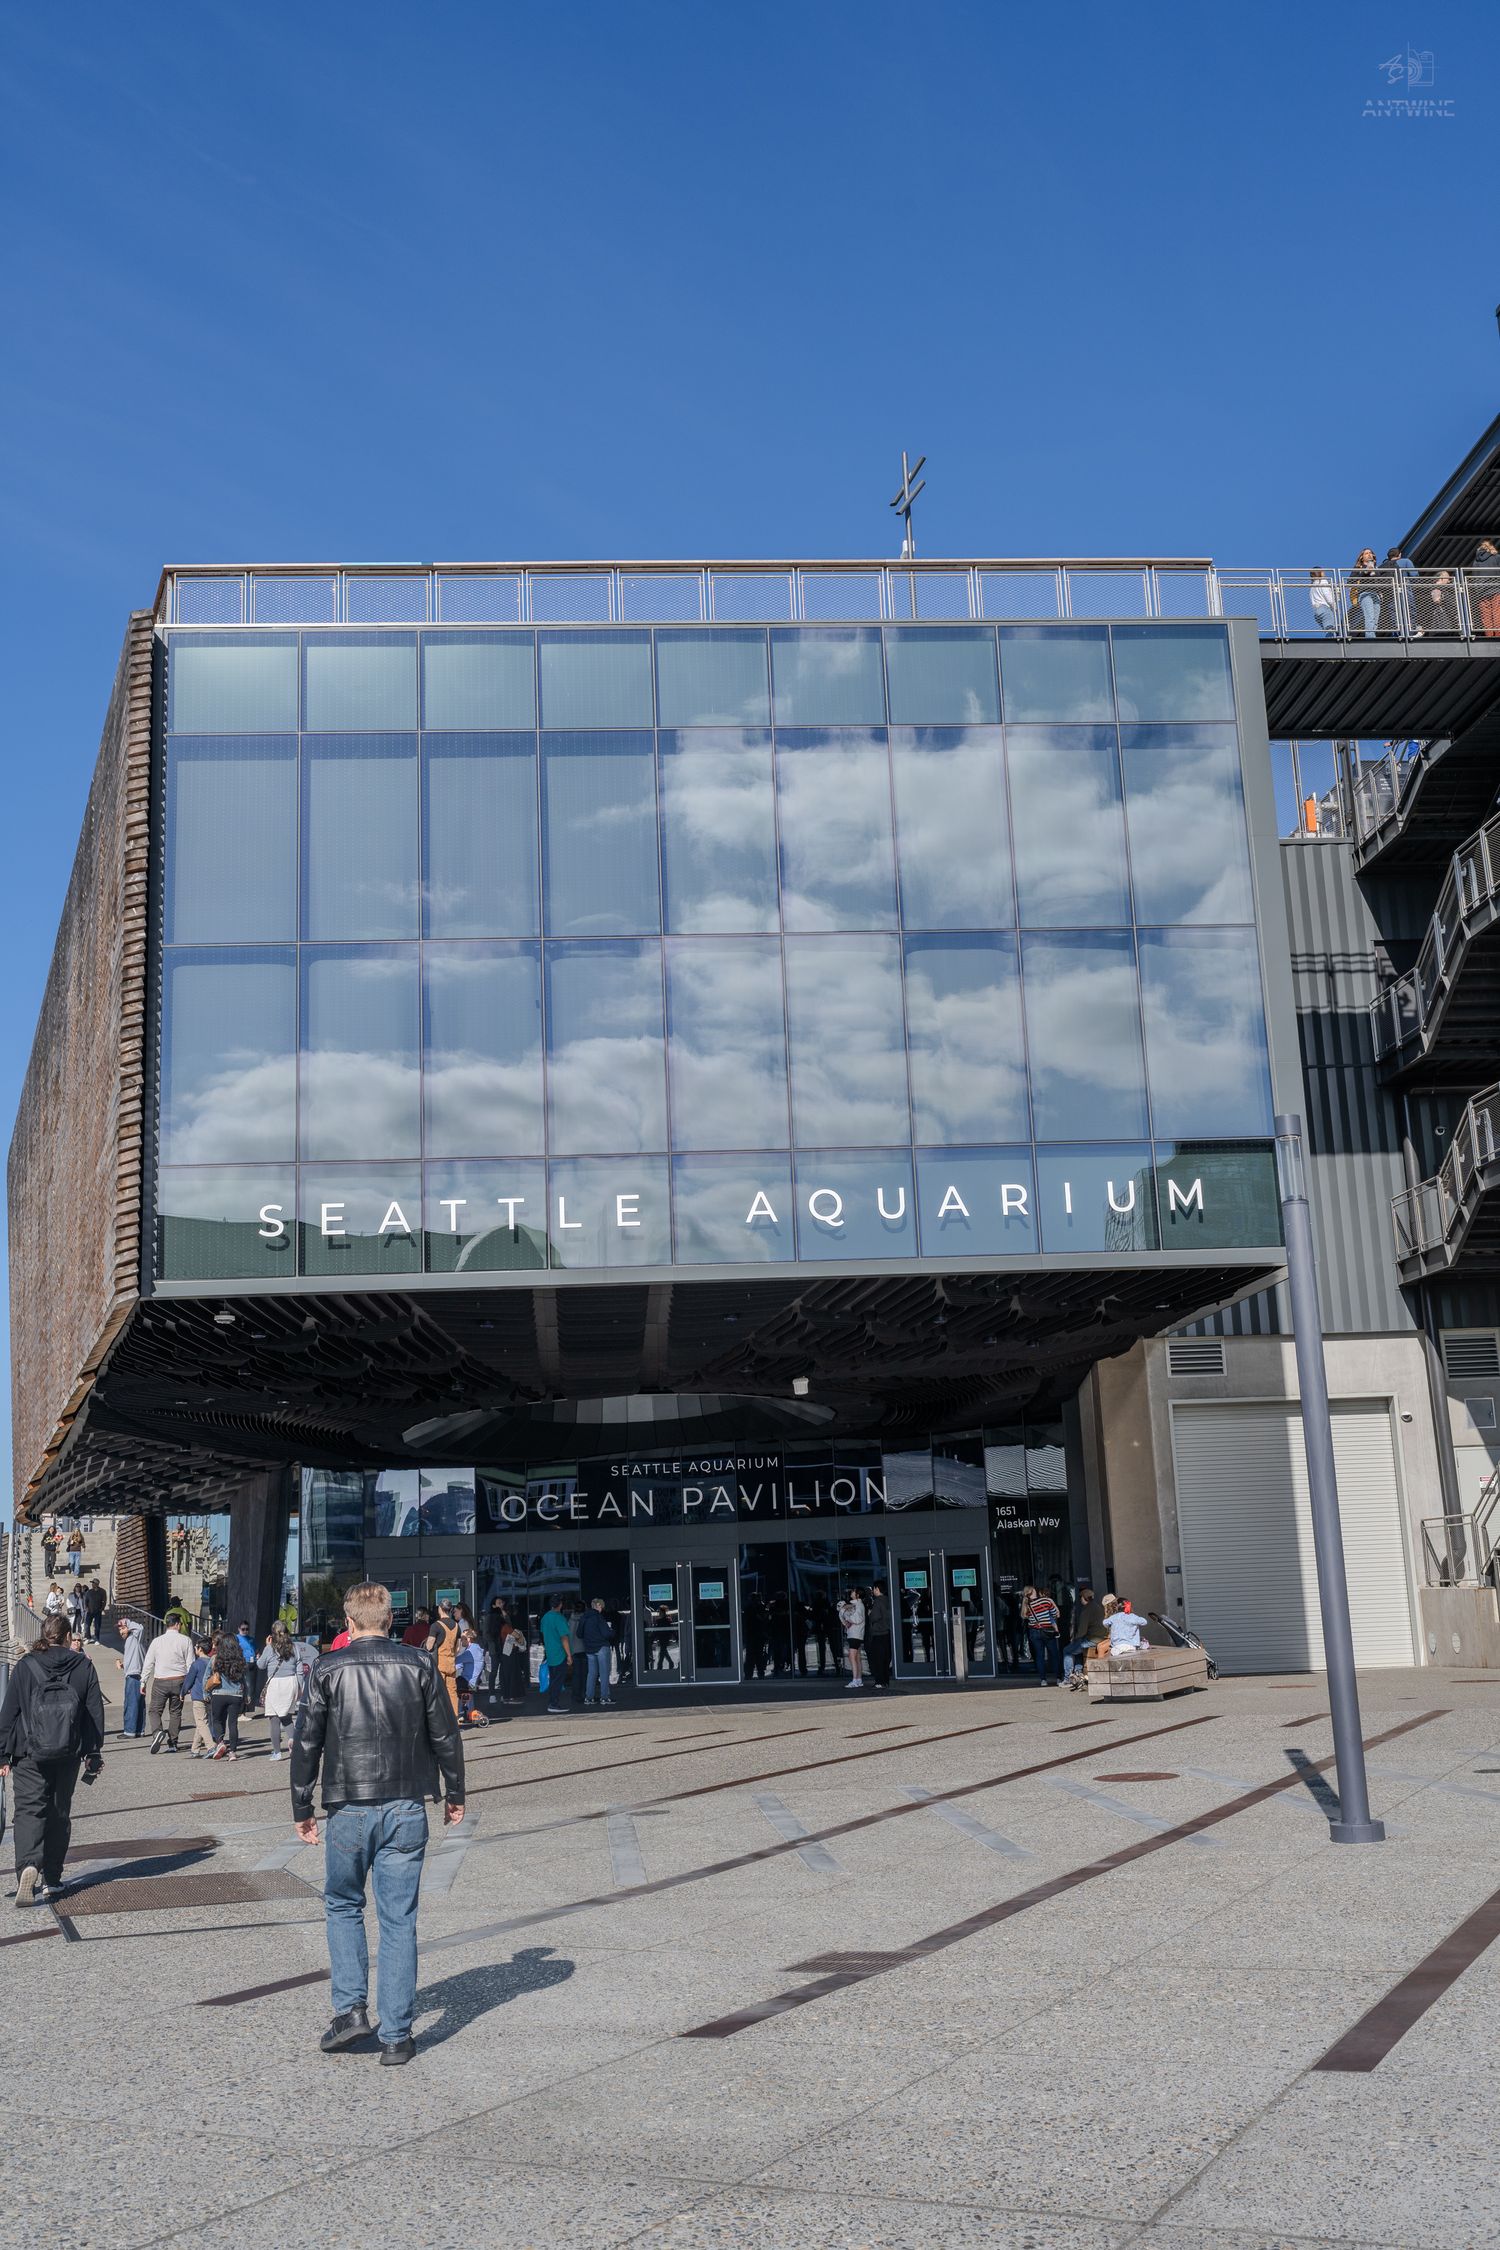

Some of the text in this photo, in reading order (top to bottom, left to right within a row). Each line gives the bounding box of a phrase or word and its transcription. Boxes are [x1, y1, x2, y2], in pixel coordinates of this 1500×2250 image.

[258, 1178, 1204, 1238] SEATTLE AQUARIUM
[611, 1456, 779, 1477] SEATTLE AQUARIUM
[500, 1489, 654, 1523] OCEAN
[682, 1475, 888, 1515] PAVILION
[995, 1505, 1017, 1517] 1651
[996, 1516, 1061, 1530] Alaskan Way
